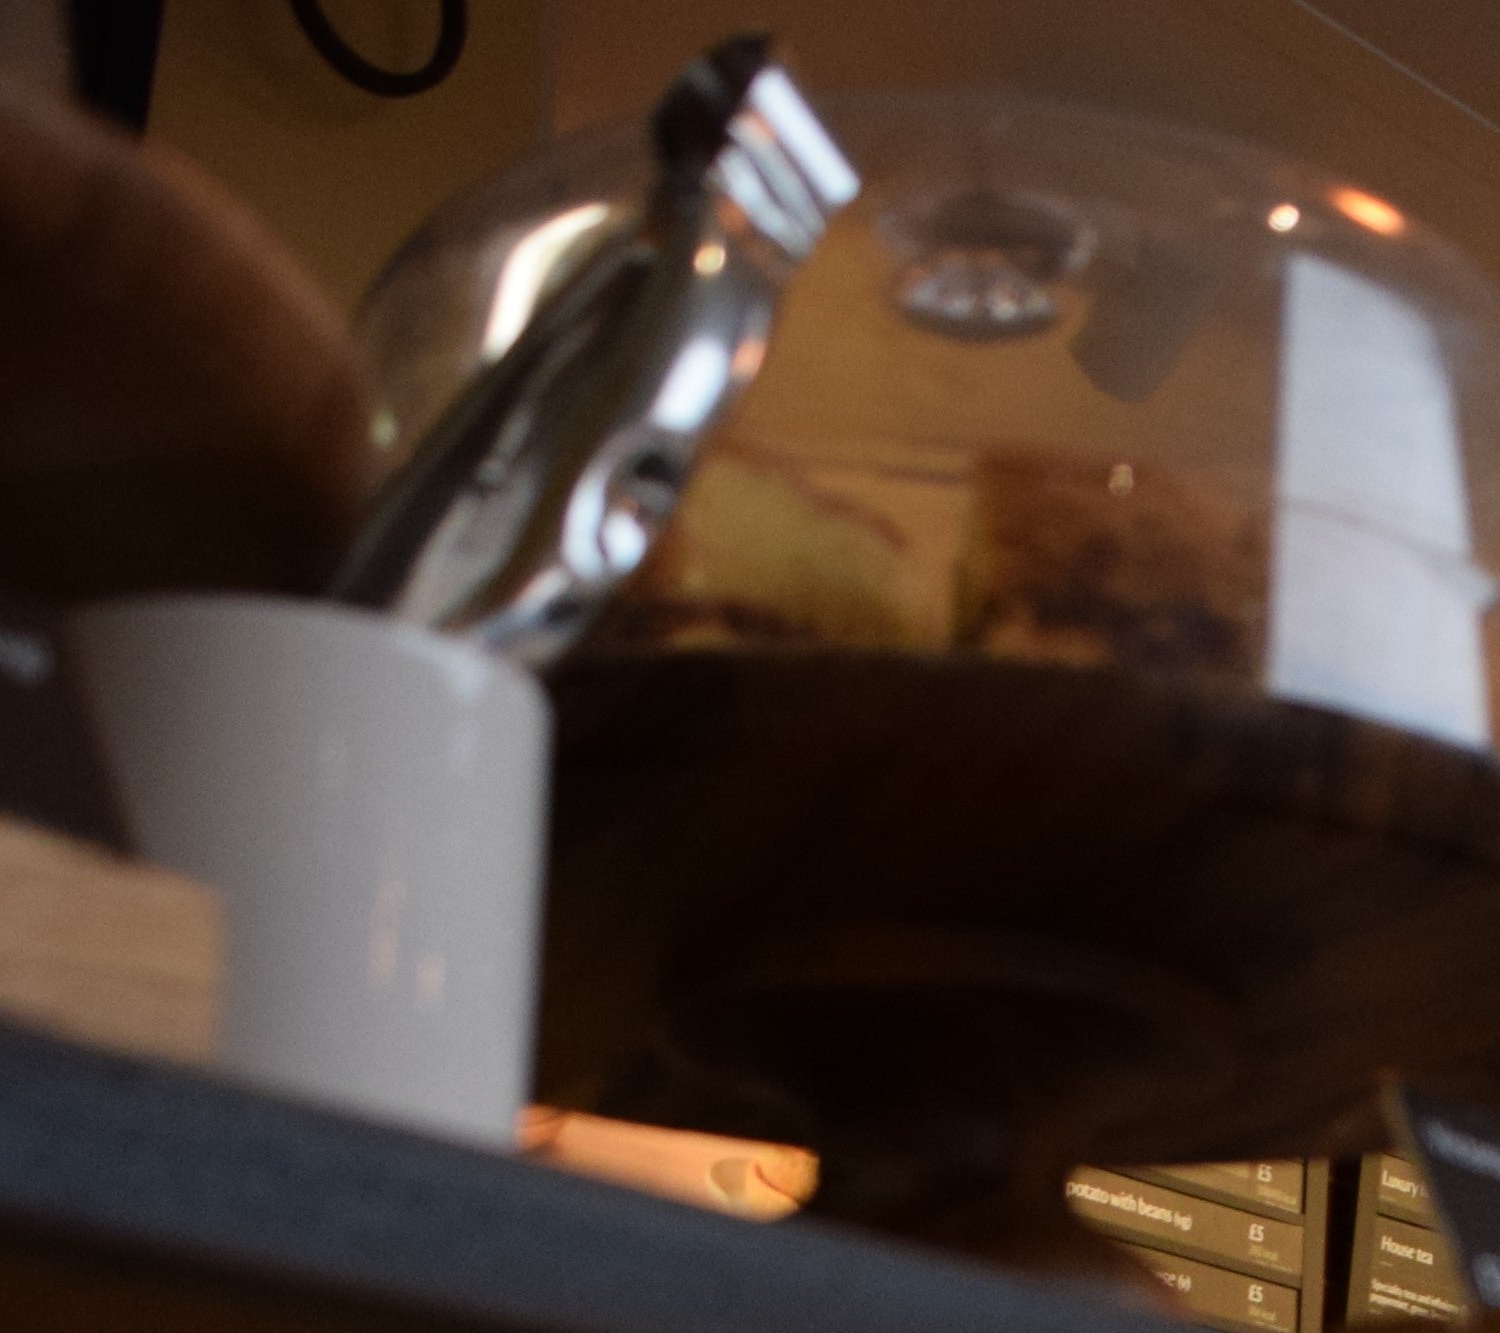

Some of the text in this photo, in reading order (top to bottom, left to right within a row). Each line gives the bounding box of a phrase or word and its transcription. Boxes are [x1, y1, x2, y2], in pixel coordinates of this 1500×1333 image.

[1257, 1164, 1273, 1183] £5
[1381, 1169, 1419, 1198] Luxury
[1110, 1190, 1137, 1212] with
[1137, 1197, 1174, 1223] beans
[1249, 1223, 1265, 1243] £5
[1381, 1235, 1434, 1265] House tea
[1248, 1284, 1264, 1303] £5
